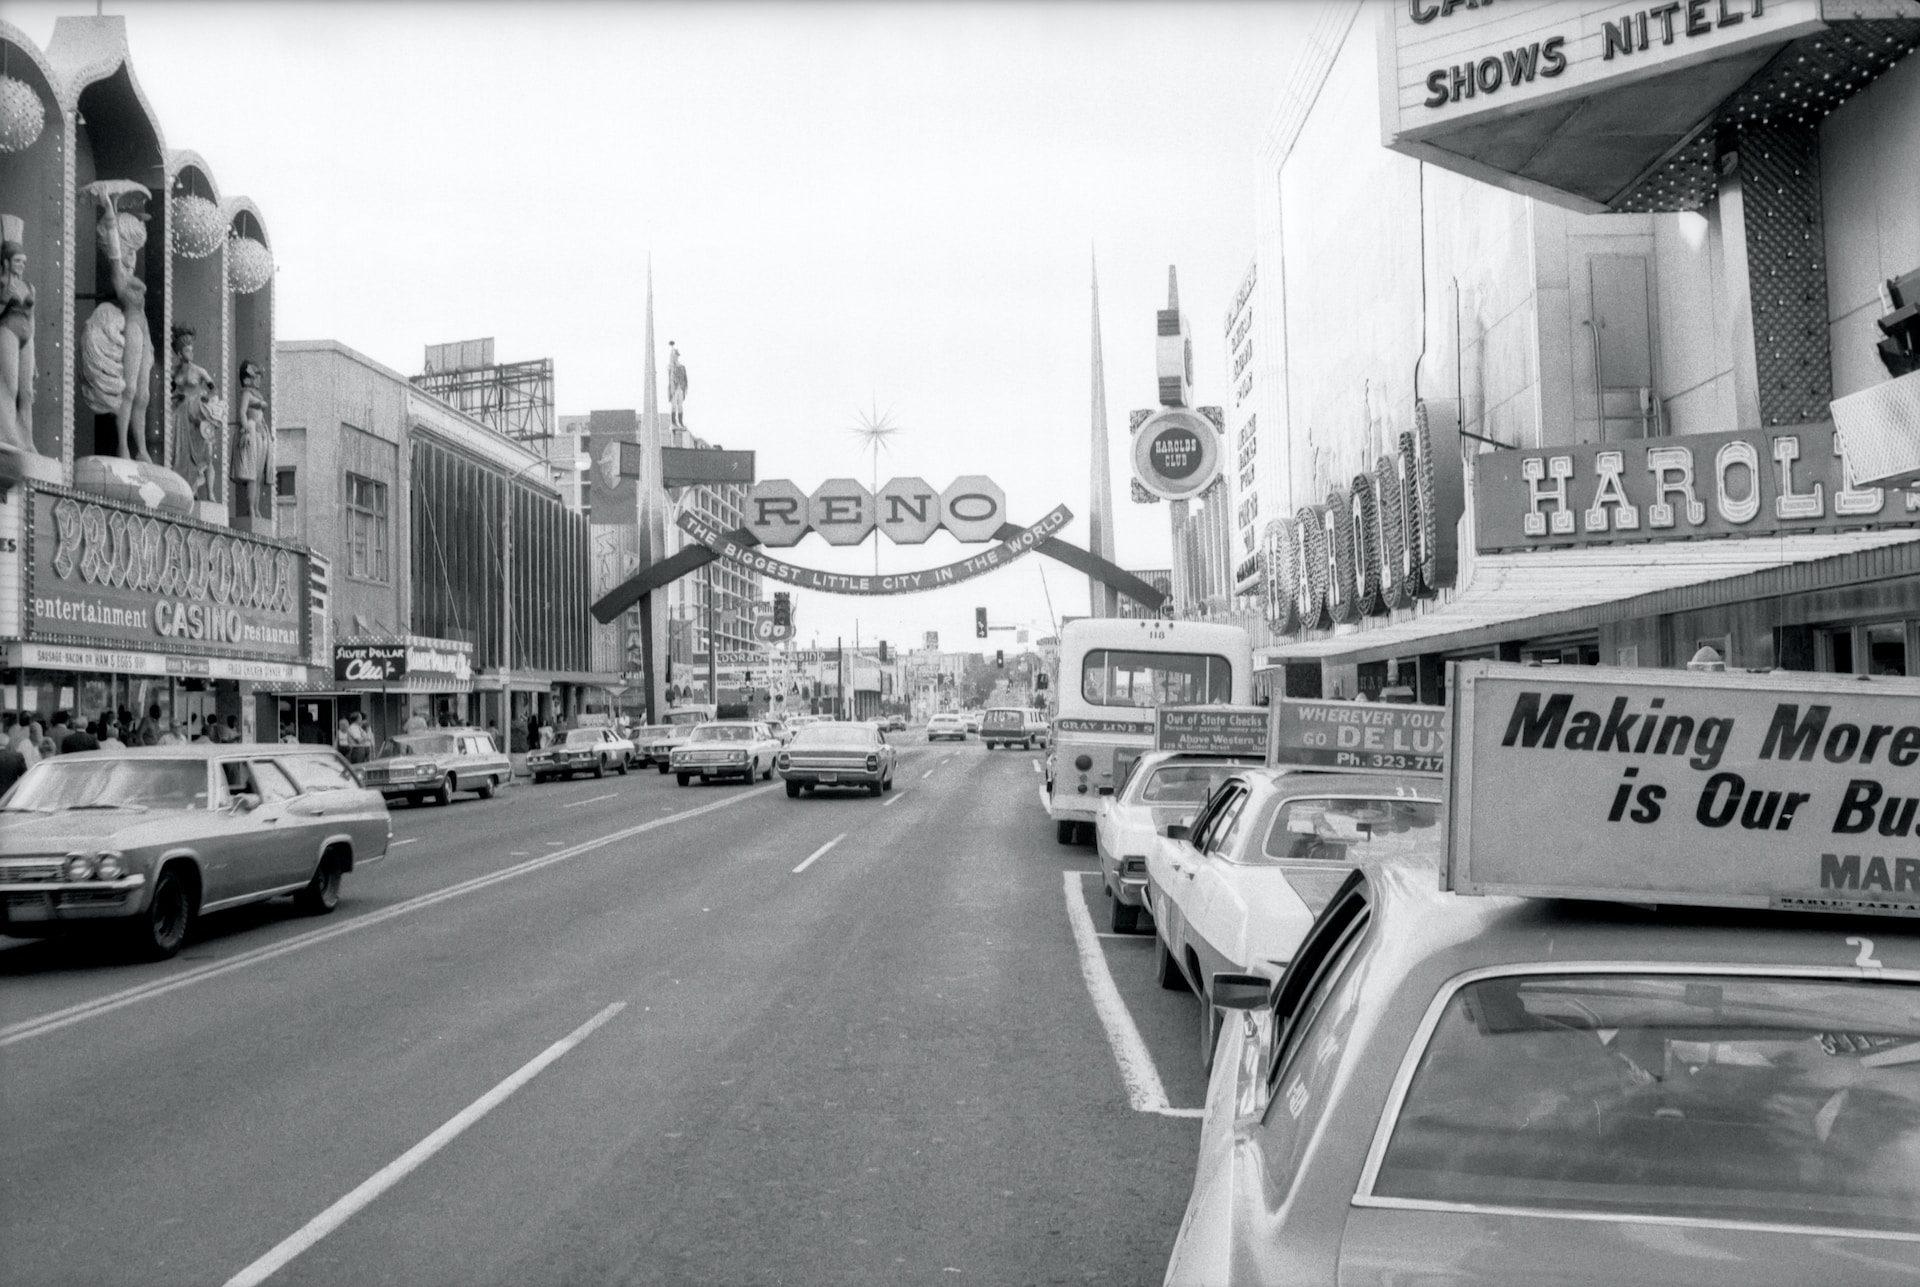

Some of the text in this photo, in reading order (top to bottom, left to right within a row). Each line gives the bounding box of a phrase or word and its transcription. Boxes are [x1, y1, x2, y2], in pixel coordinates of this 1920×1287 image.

[1424, 36, 1567, 108] SHOWS
[1155, 438, 1197, 453] HAROLDS
[1165, 453, 1188, 467] CLUB
[754, 493, 997, 525] RENO
[53, 498, 294, 614] PRIMADONNA
[686, 511, 1064, 590] THE BIGGEST LITTLE CITY IN THE WORLD
[35, 598, 300, 645] entertainment CASINO restaurant
[1150, 631, 1166, 640] 118
[336, 646, 405, 659] SILVER DOLLAR
[1062, 720, 1098, 730] GRAY
[1102, 723, 1137, 732] LINE
[1166, 713, 1262, 727] Out of State Checks
[1298, 706, 1435, 728] WHEREVER YOU
[1180, 734, 1210, 744] Above
[1212, 735, 1254, 745] Western
[1303, 732, 1327, 746] GO
[1502, 692, 1920, 771] Making More
[1336, 752, 1366, 767] Ph.
[1607, 767, 1920, 837] is Our Bu
[1845, 936, 1882, 968] 2
